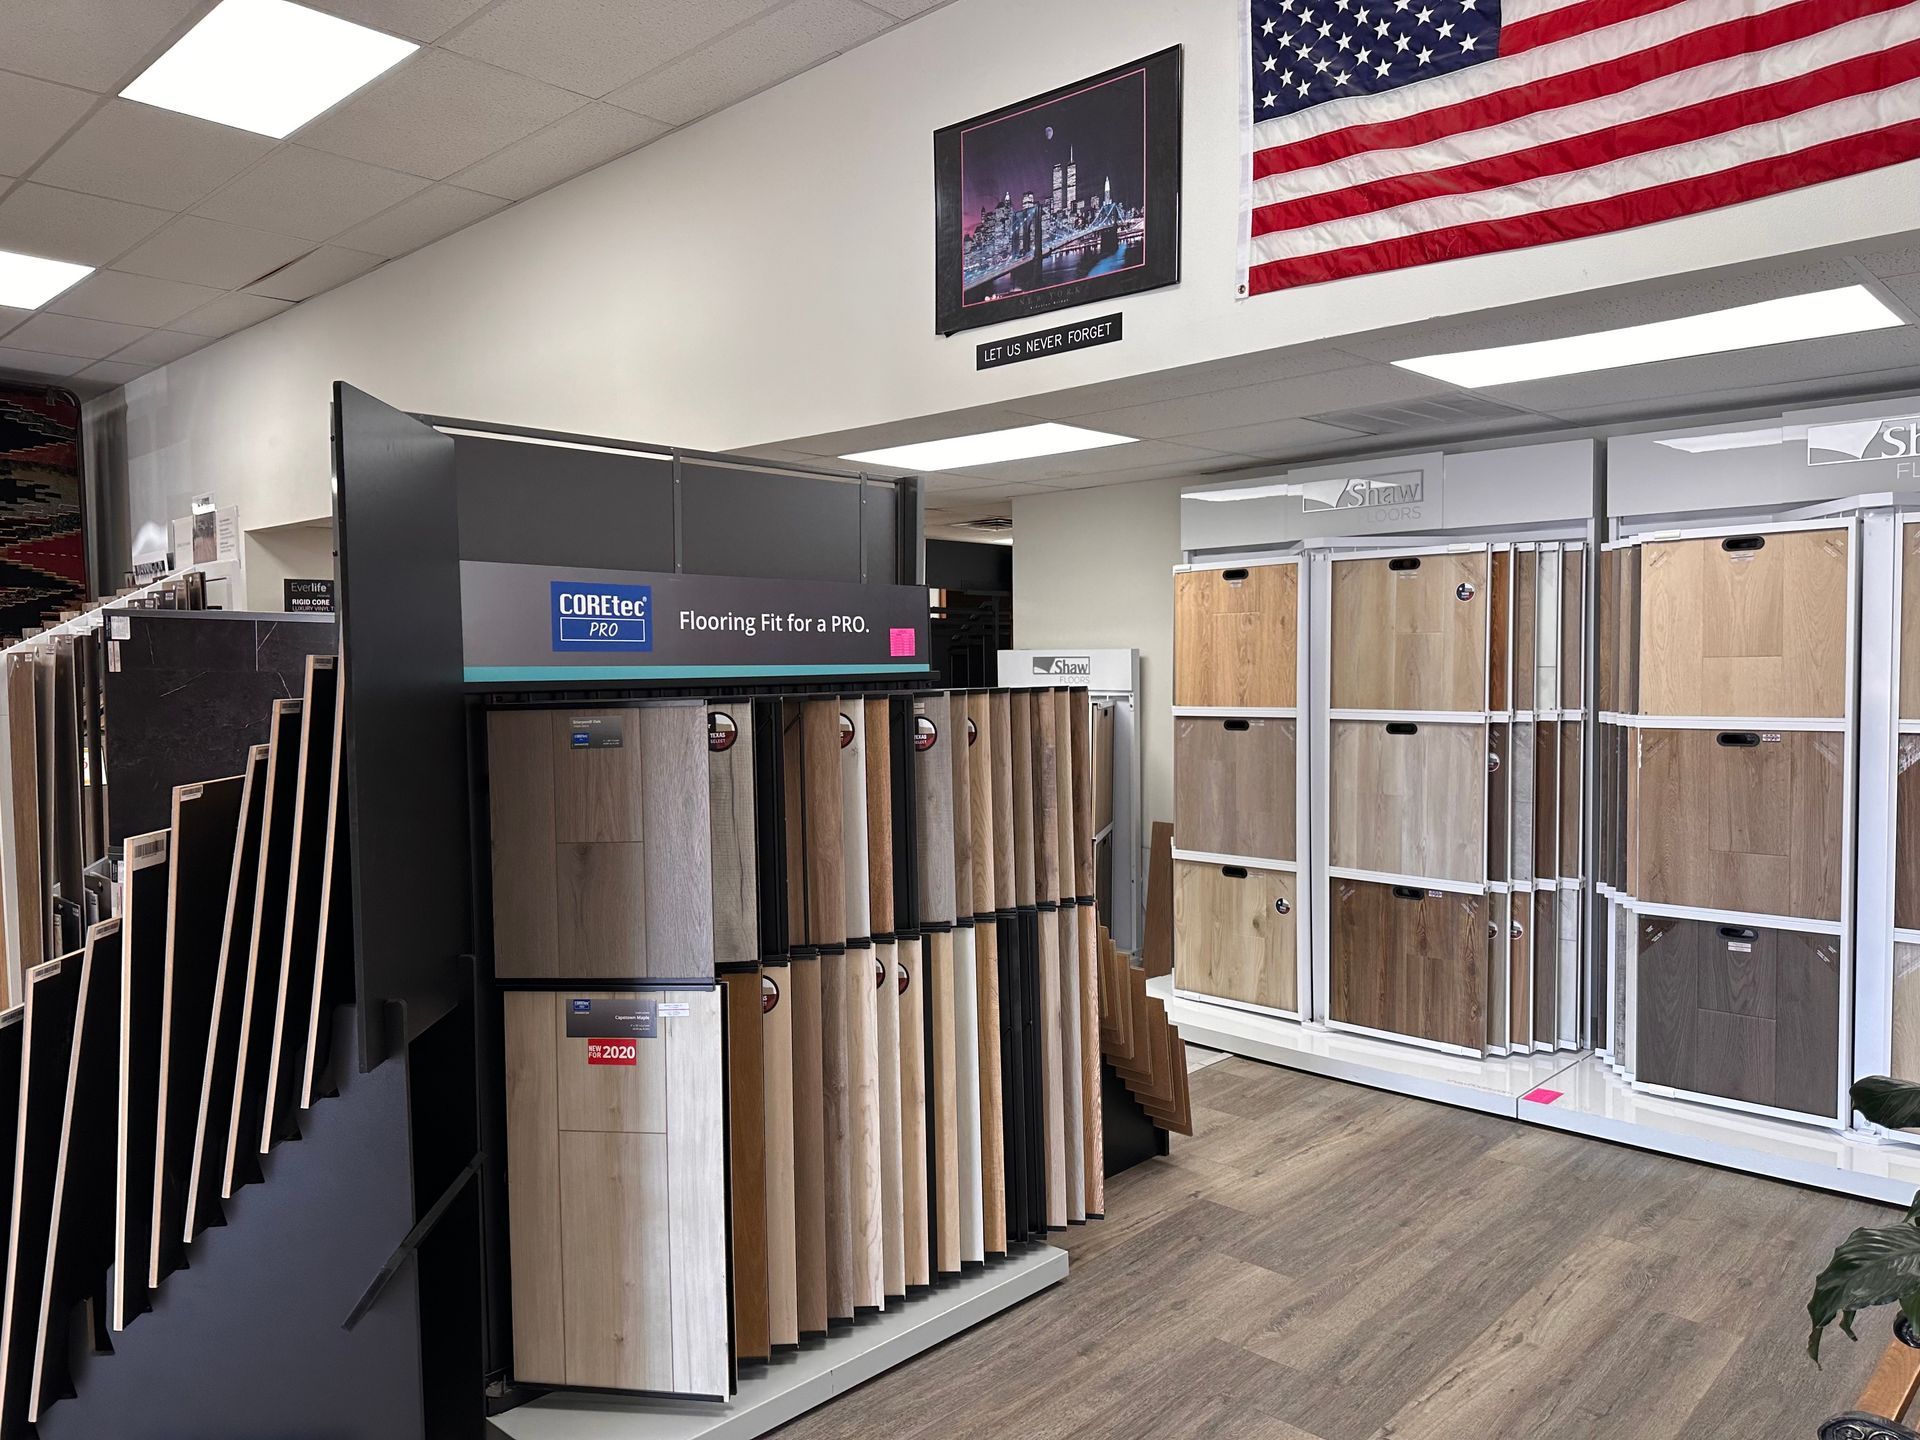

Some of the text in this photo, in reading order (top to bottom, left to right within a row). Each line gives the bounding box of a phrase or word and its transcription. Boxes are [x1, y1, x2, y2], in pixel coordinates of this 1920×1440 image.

[984, 322, 1112, 362] LET US NEVER FORGET
[1347, 480, 1420, 507] Shaw
[291, 582, 327, 592] Everlife
[311, 598, 330, 606] CORE
[559, 593, 646, 617] COREtec
[589, 621, 618, 637] PRO
[679, 611, 870, 637] Flooring Fit for a PRO.
[1054, 659, 1088, 675] Shaw
[1059, 676, 1090, 684] FLOORS
[602, 1045, 636, 1059] 2020
